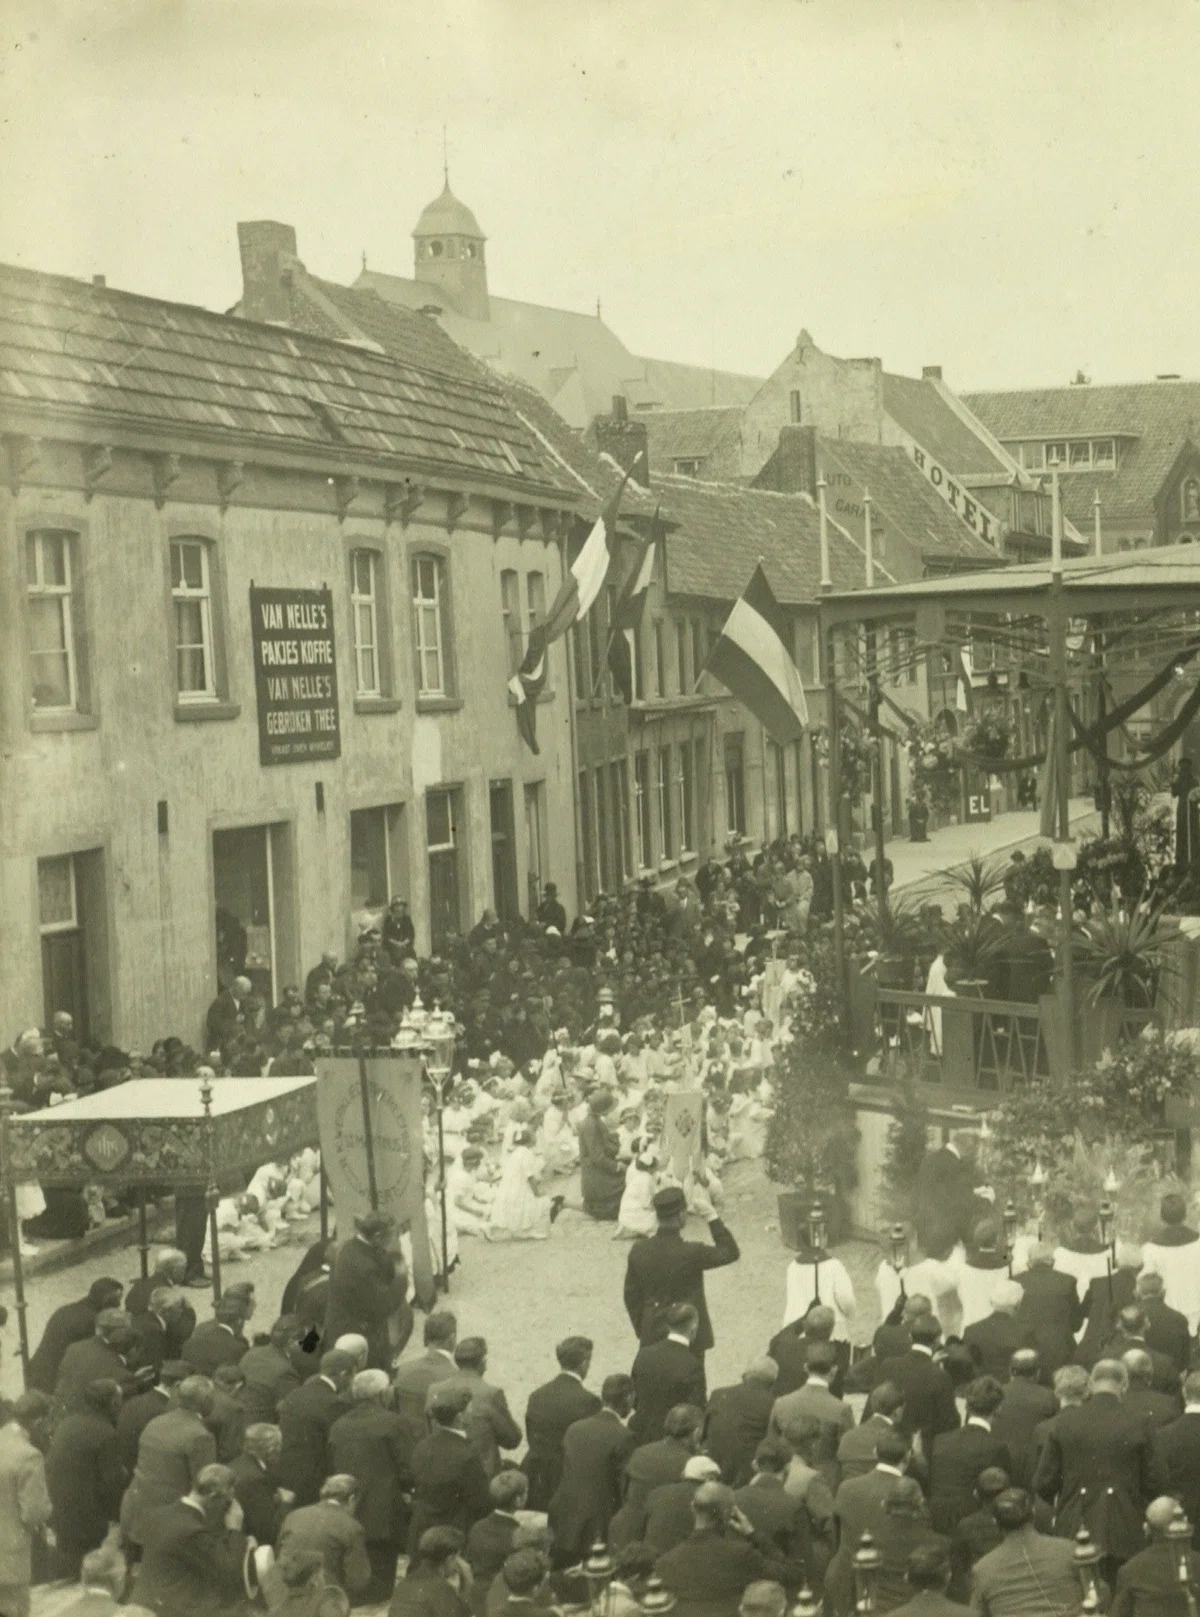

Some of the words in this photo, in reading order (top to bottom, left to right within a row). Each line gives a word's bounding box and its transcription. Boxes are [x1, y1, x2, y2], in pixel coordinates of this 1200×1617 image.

[819, 473, 852, 486] UTO
[914, 447, 995, 547] HOTEL
[261, 604, 283, 629] VAN
[286, 603, 327, 629] NELLE'S
[261, 640, 299, 665] PAKJES
[301, 640, 333, 664] KOFFIE
[267, 676, 289, 700] VAN
[292, 674, 332, 699] NELLE'S
[266, 710, 312, 735] GEBROKEN
[314, 708, 336, 731] THEE
